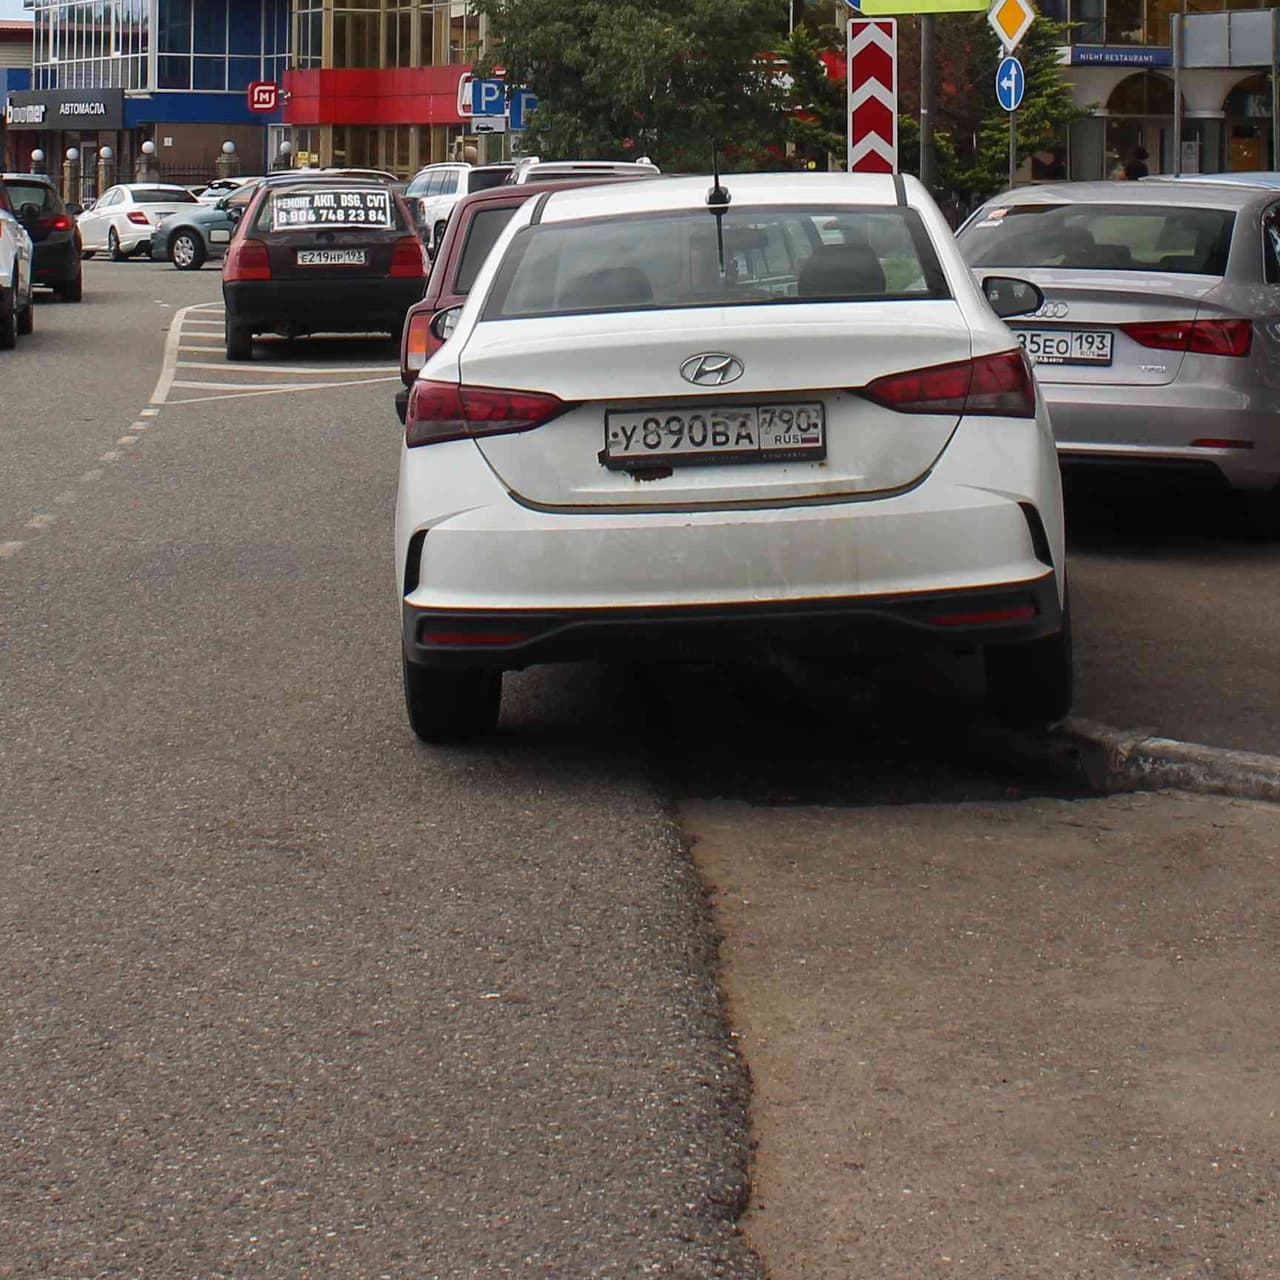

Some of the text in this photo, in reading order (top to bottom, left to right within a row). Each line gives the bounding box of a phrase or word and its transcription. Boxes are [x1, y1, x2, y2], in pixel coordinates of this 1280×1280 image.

[1080, 53, 1153, 62] NIGHT RESTAURANT
[59, 102, 106, 115] АВТОМАСЛА
[313, 194, 337, 207] АКП,
[340, 194, 364, 208] DSG,
[366, 195, 385, 207] CVT
[278, 211, 287, 223] 8
[320, 209, 345, 221] 748
[348, 209, 365, 221] 23
[368, 209, 386, 222] 84
[1075, 334, 1106, 351] 193
[621, 413, 754, 451] У890ВА
[774, 434, 800, 444] RUS
